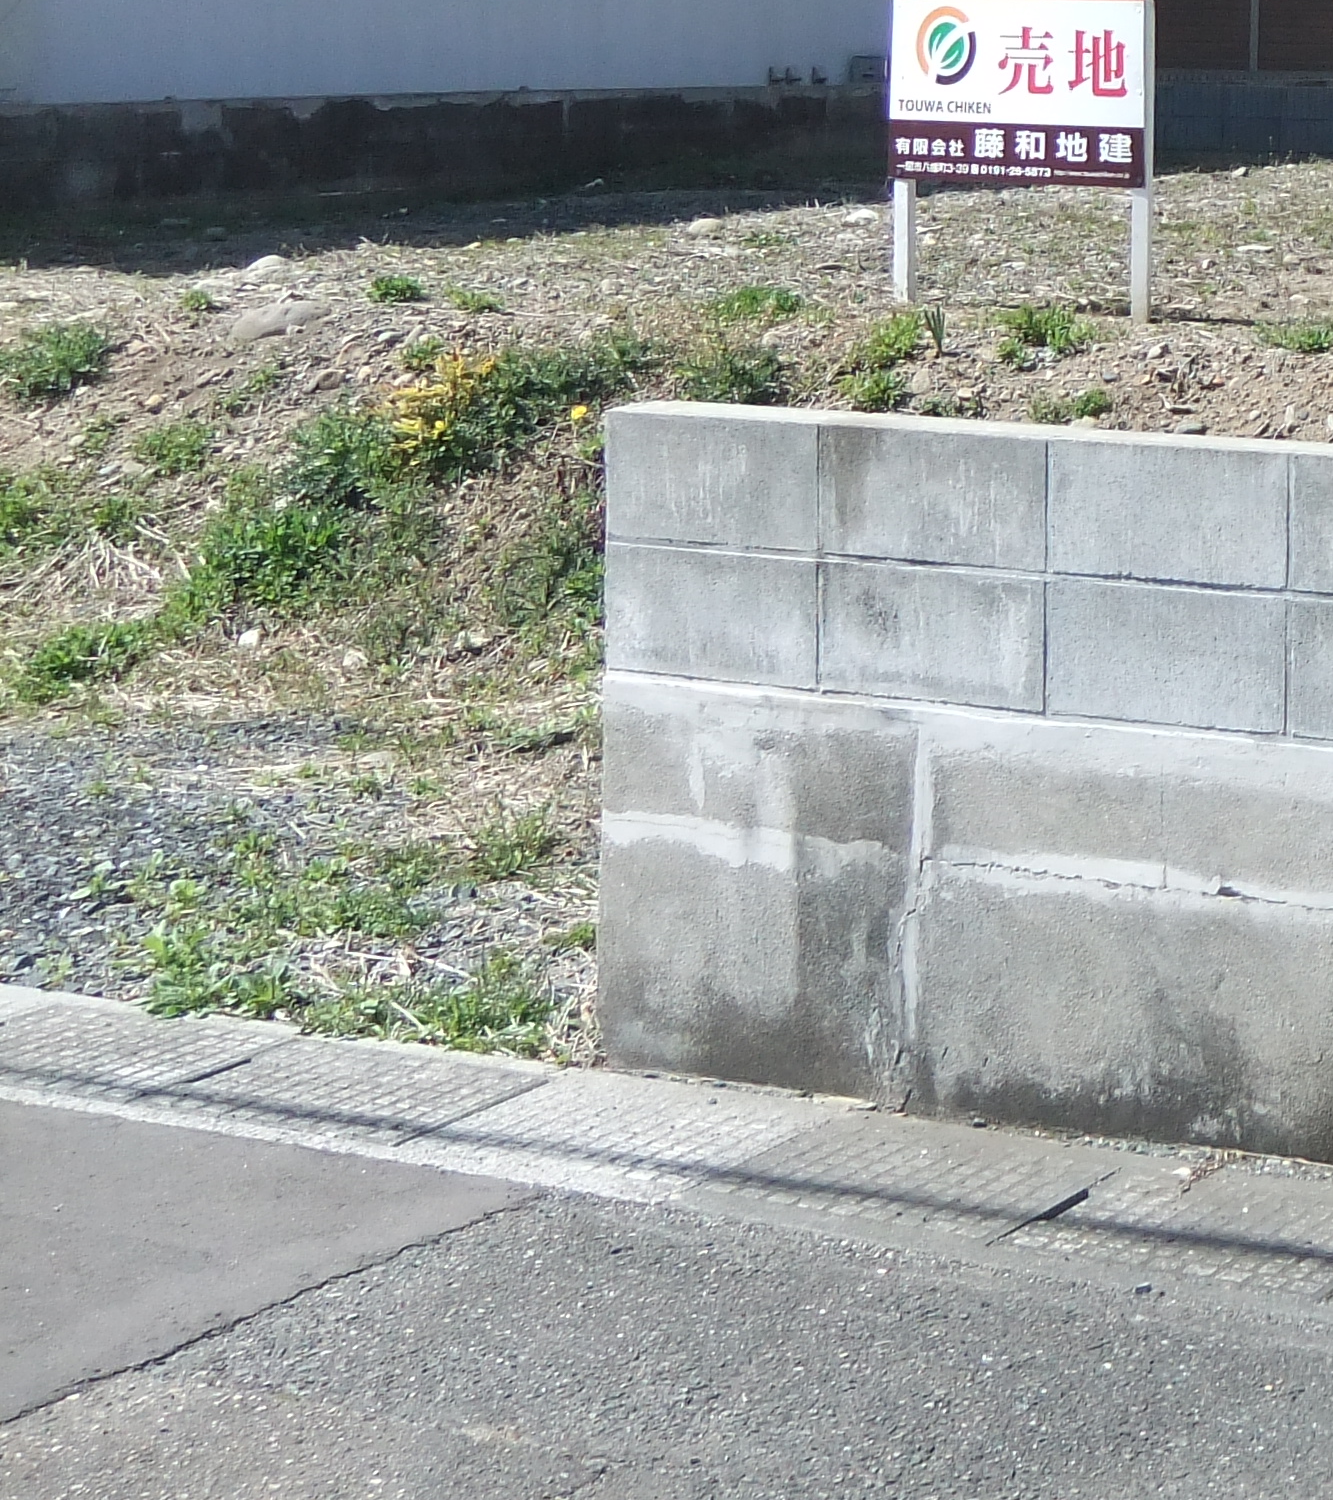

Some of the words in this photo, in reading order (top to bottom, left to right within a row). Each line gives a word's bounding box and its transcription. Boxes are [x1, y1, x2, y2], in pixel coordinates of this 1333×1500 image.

[998, 26, 1128, 98] 売地
[898, 99, 944, 114] TOUWA
[947, 101, 991, 114] CHIKEN
[895, 138, 965, 157] 有限会社
[974, 128, 1133, 164] 藤和地建
